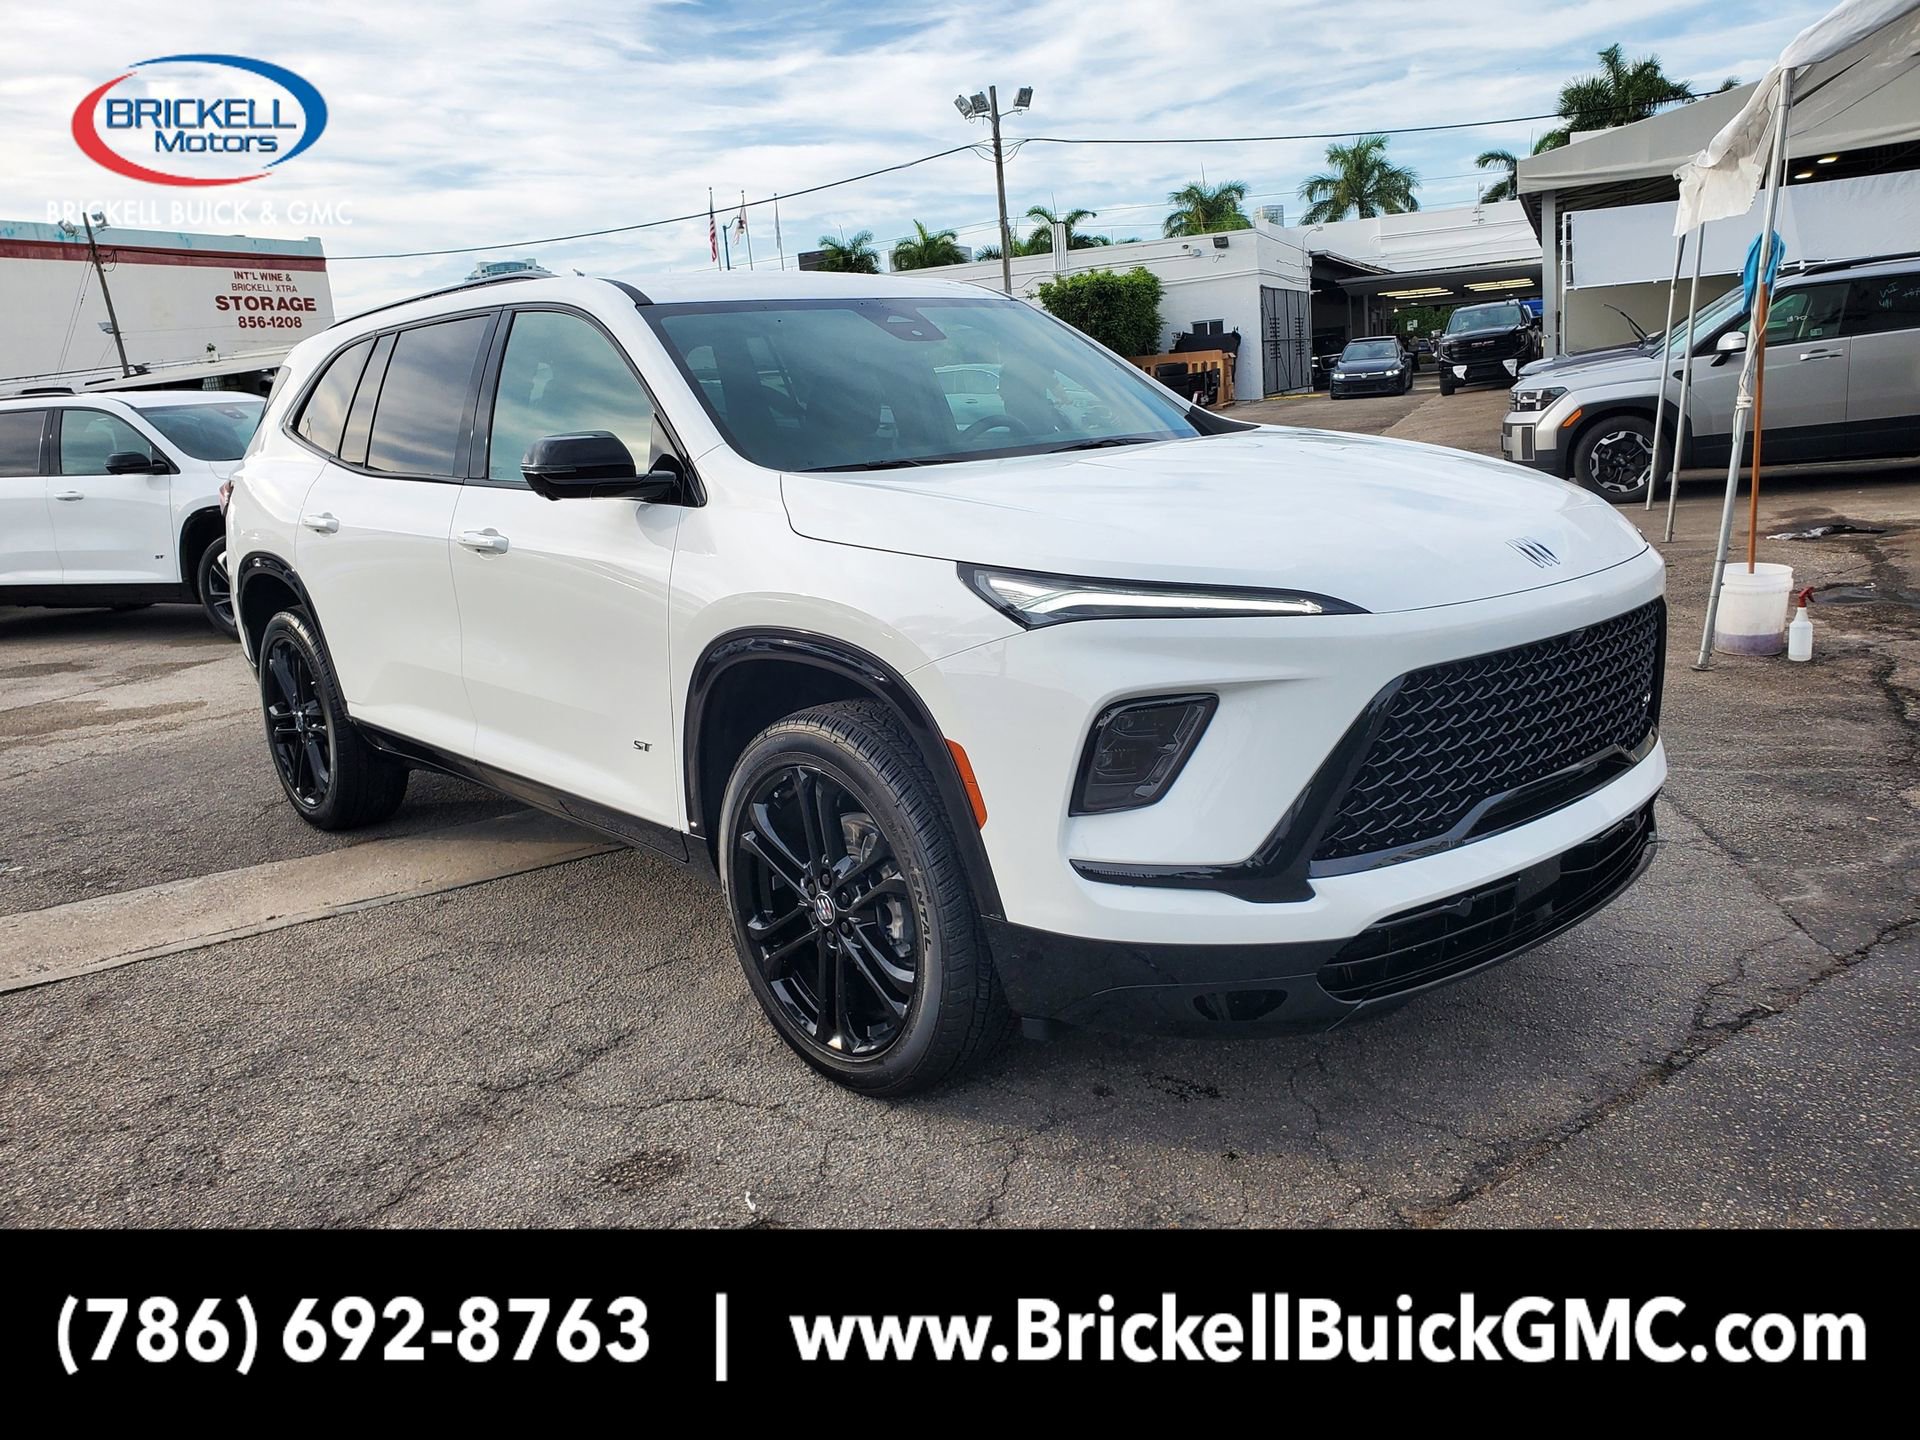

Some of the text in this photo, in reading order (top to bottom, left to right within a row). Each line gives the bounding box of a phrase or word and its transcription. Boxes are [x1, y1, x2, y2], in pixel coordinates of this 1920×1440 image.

[233, 271, 292, 282] INT'L WINE &
[231, 283, 298, 293] BRICKELL XTRA
[215, 295, 317, 312] STORAGE
[237, 316, 303, 329] 856-1208
[633, 740, 653, 752] ST
